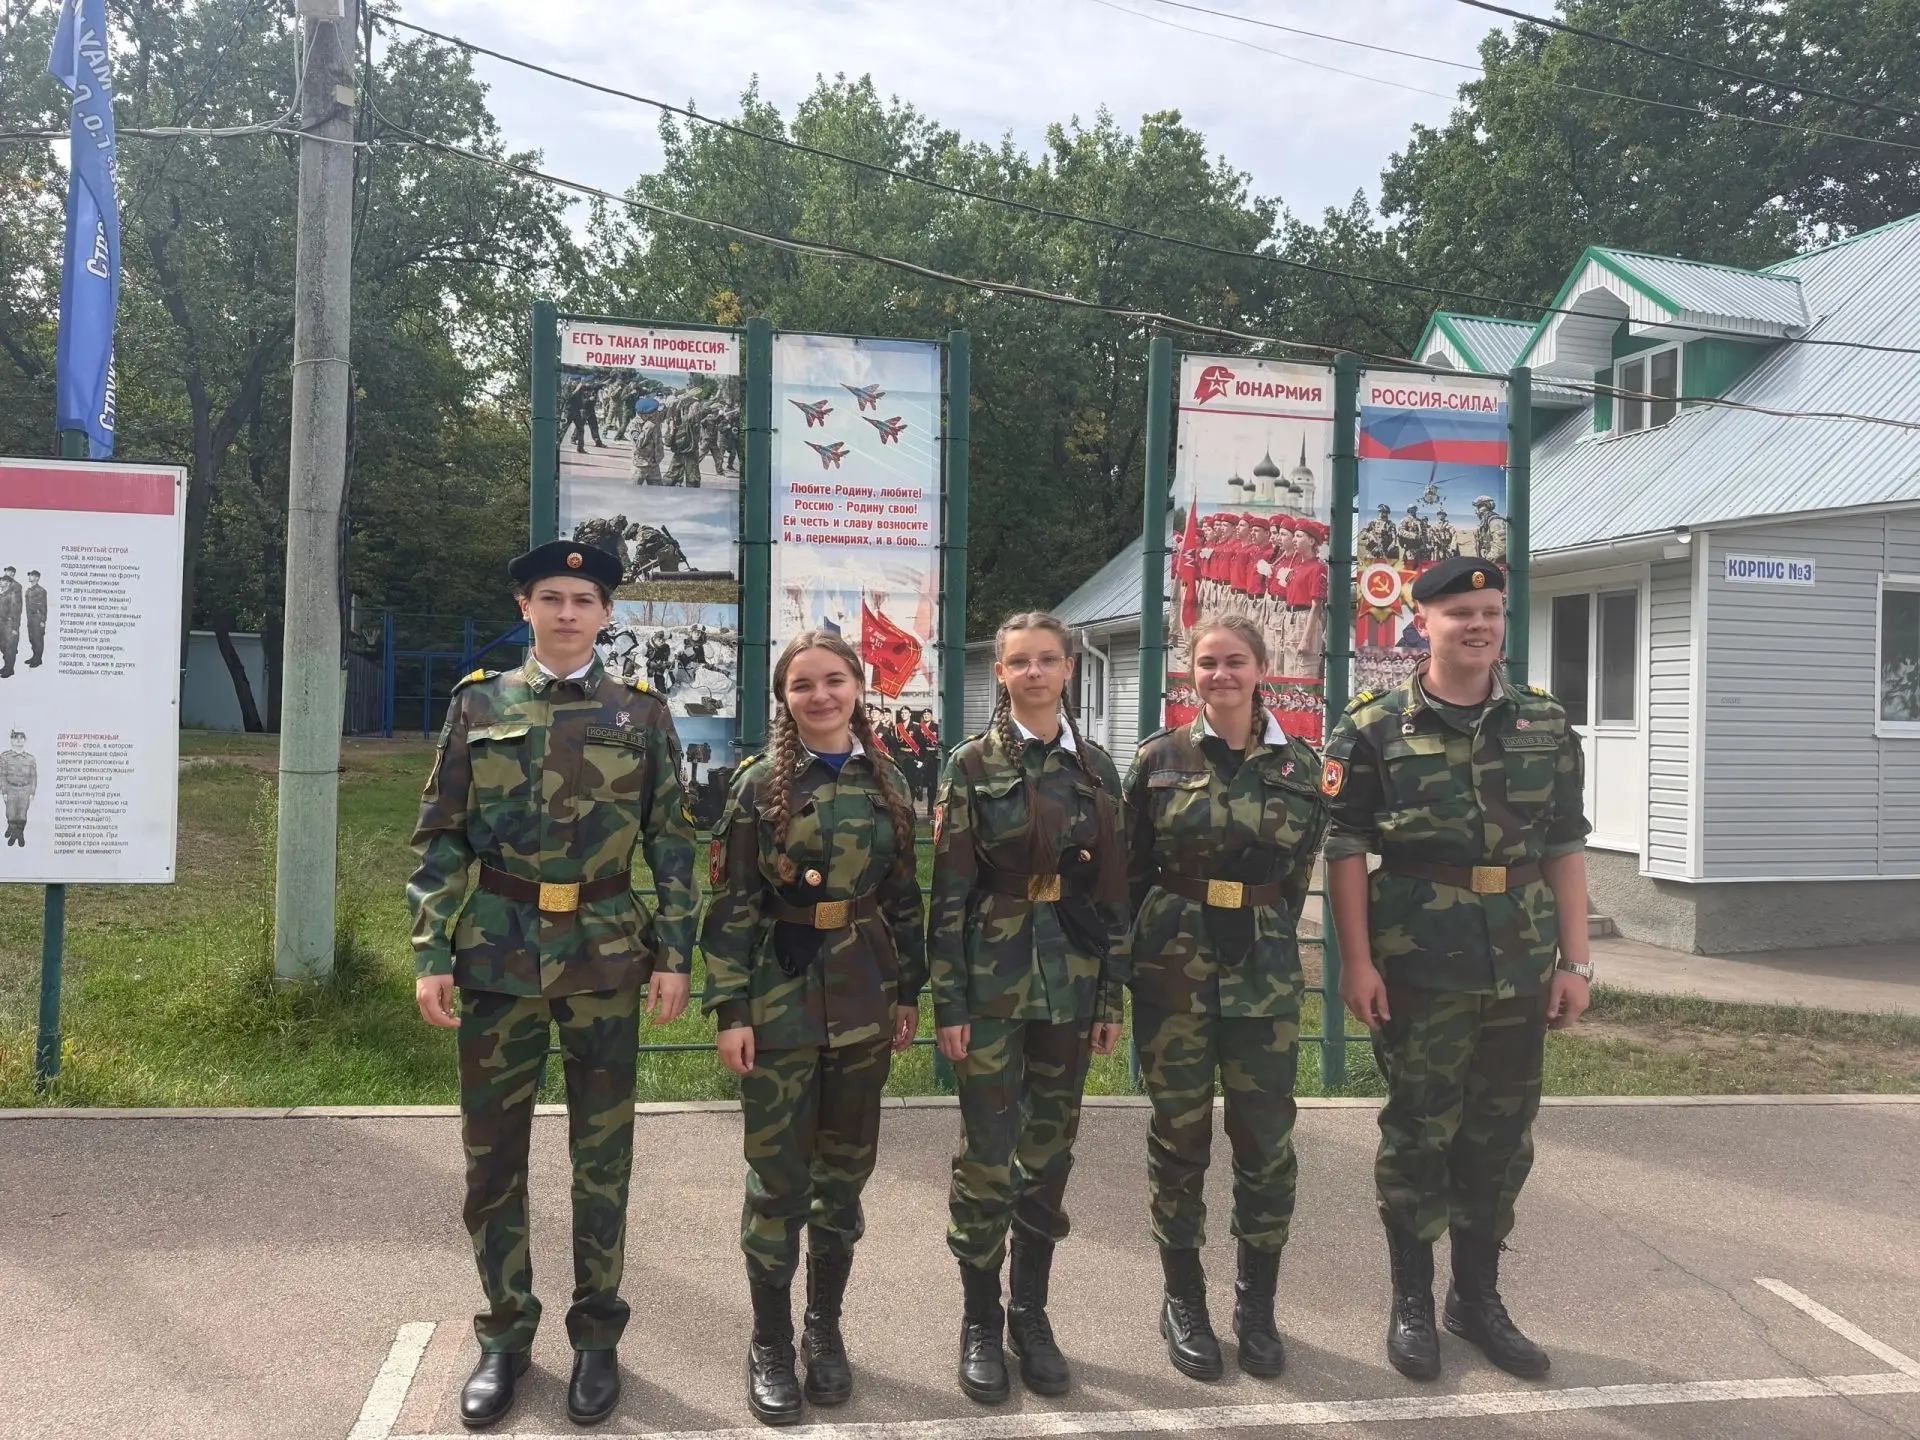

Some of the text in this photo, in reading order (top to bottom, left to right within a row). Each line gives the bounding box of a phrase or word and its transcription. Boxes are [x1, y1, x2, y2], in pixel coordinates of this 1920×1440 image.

[573, 333, 729, 353] ЕСТЬ ТАКАЯ ПРОФЕССИЯ-
[587, 352, 715, 371] РОДИНУ ЗАЩИЩАТЬ!
[1236, 381, 1322, 402] ЮНАРМИЯ
[1372, 389, 1497, 412] РОССИЯ-СИЛА!
[791, 483, 921, 498] Любите Родину, любите!
[795, 500, 833, 511] Россию
[847, 502, 884, 514] Родину
[889, 504, 917, 514] свою!
[784, 516, 928, 530] Ей честь и славу возносите
[784, 532, 791, 541] И
[806, 534, 871, 545] перемириях,
[897, 535, 927, 546] бою...
[1729, 560, 1811, 580] КОРПУС №3
